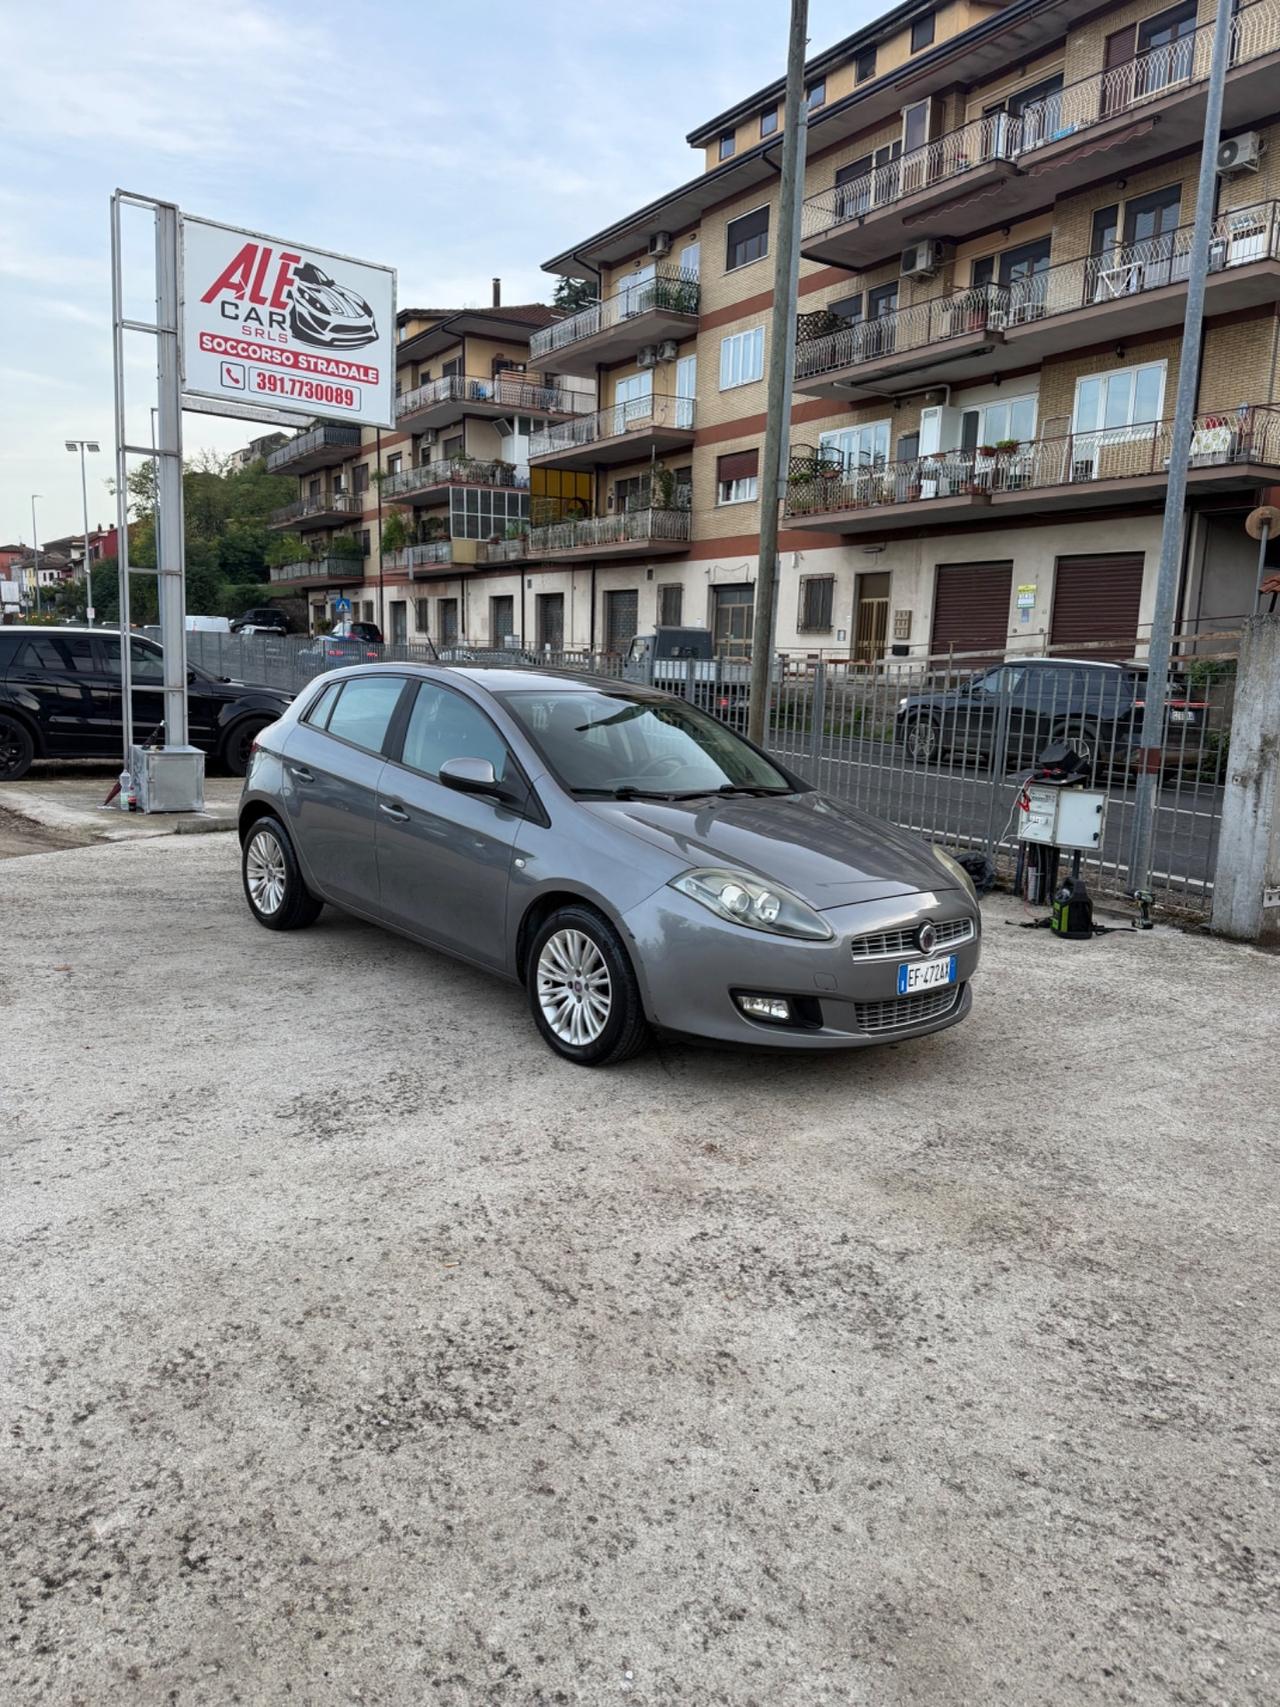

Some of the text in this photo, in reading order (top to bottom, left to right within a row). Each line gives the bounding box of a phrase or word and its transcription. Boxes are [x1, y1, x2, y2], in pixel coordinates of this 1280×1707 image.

[200, 243, 301, 310] ALE
[221, 300, 287, 331] CAR
[242, 325, 288, 344] SRLS
[202, 336, 378, 381] SOCCORSO STRADALE
[256, 372, 353, 406] 391.7730089
